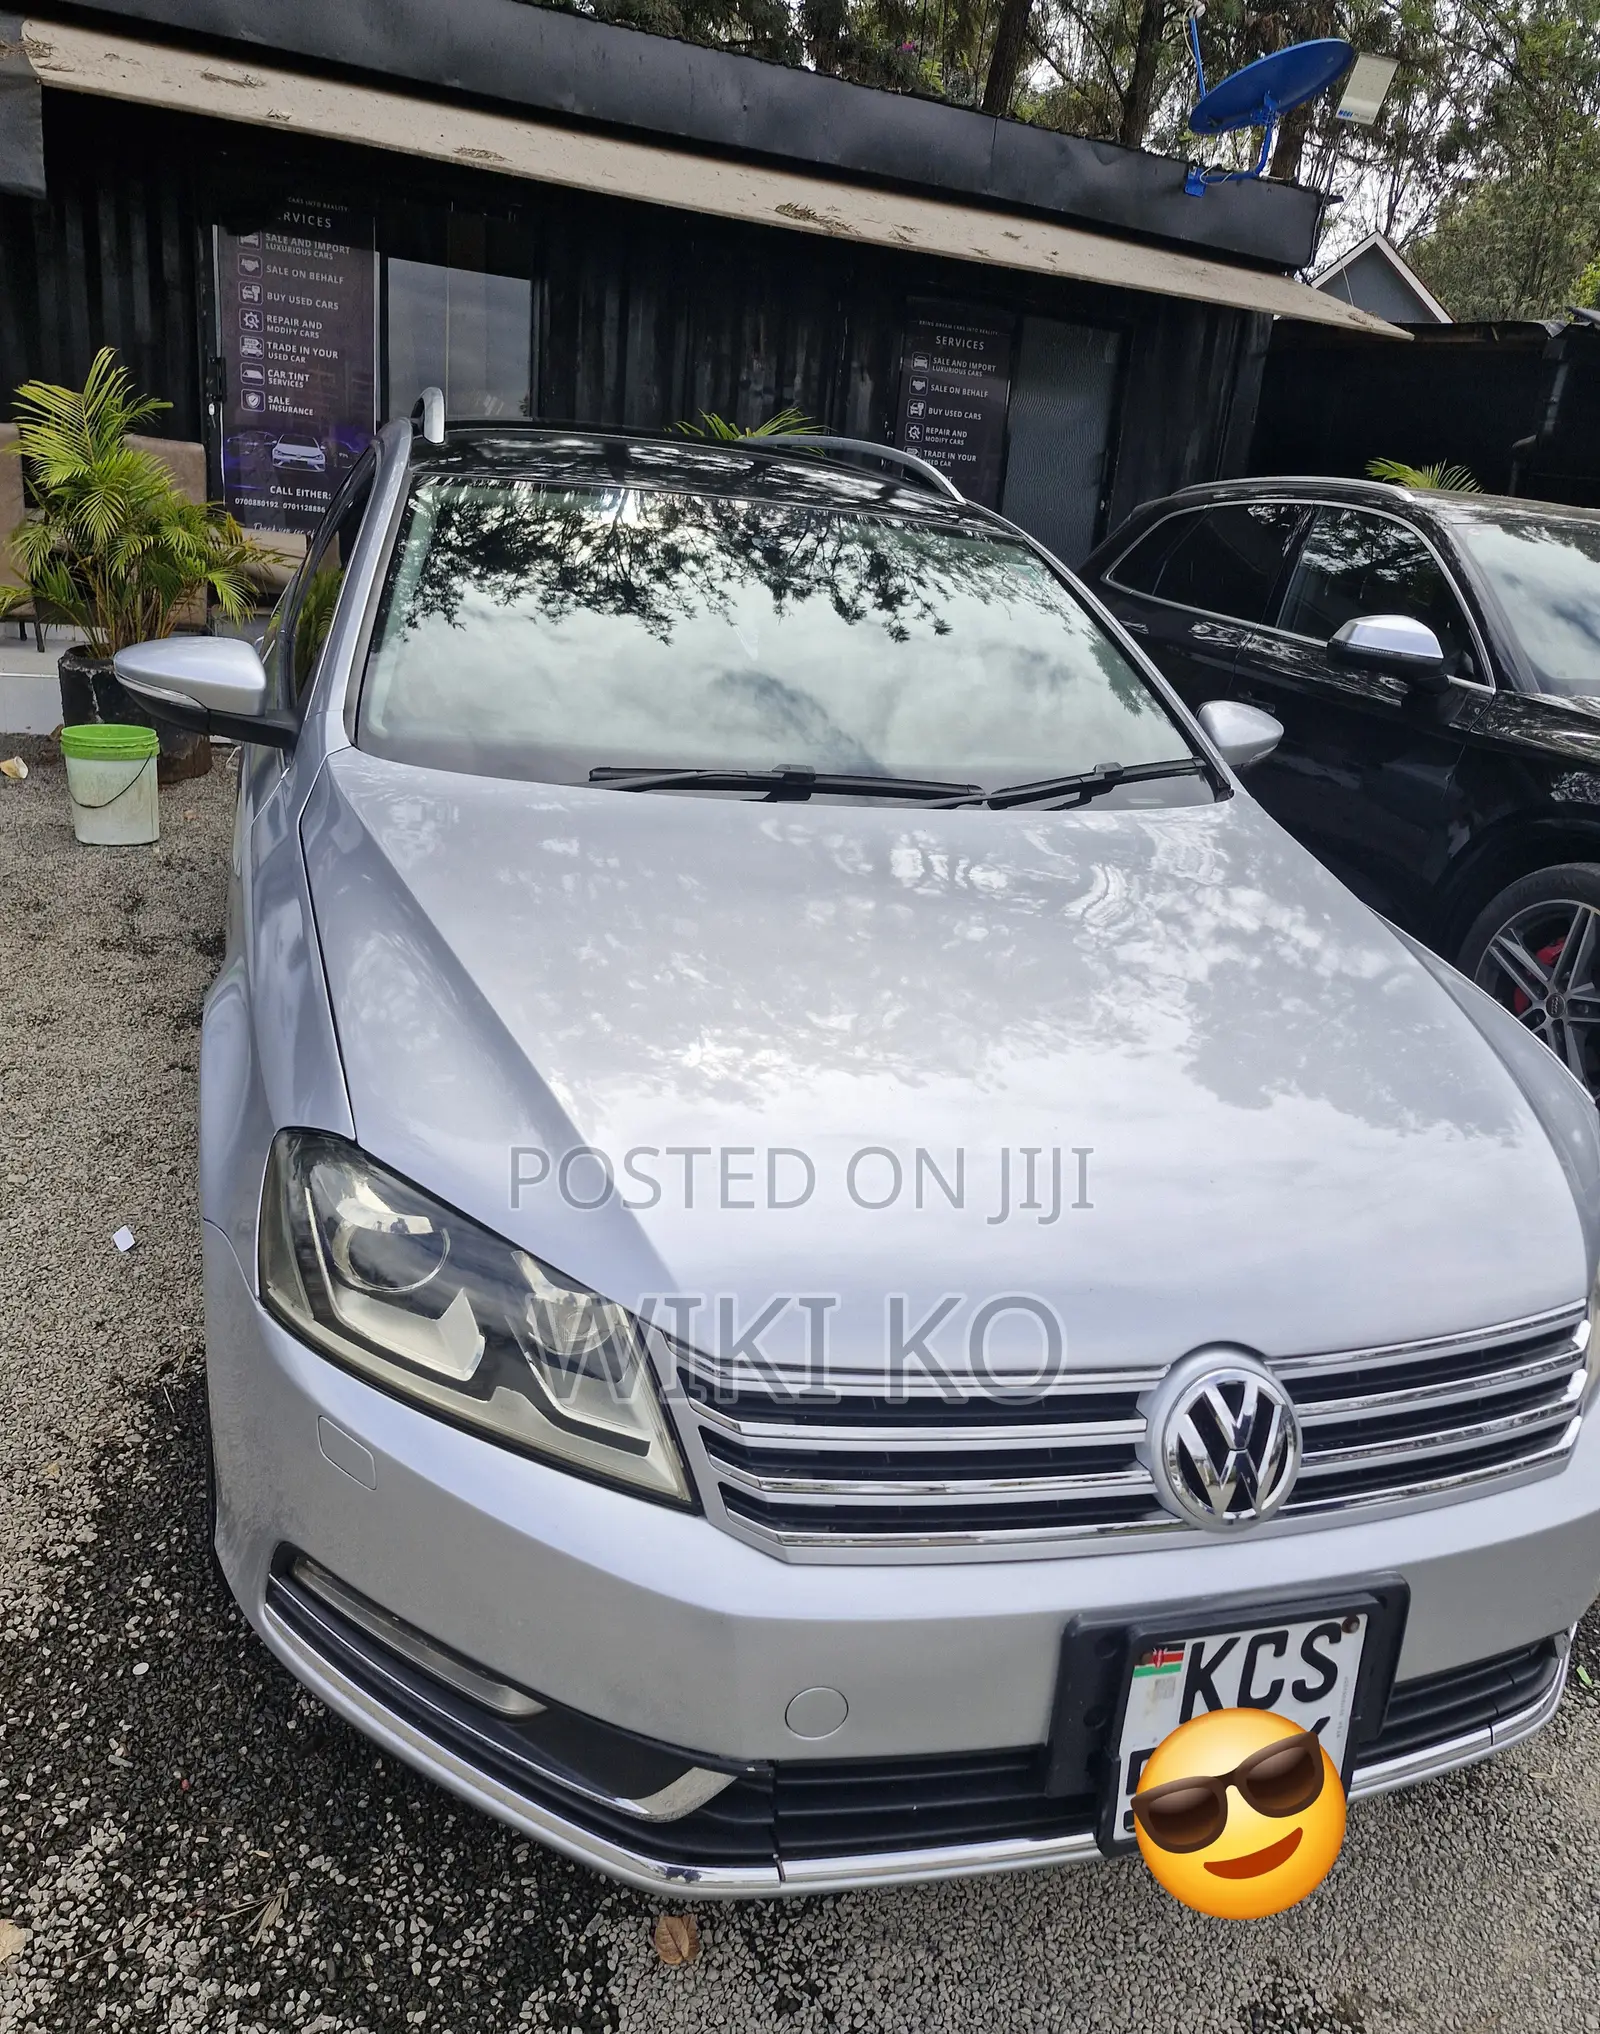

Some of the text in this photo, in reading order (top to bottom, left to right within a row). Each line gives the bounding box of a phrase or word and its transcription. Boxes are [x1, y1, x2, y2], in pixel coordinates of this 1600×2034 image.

[277, 212, 332, 229] RVICES
[265, 233, 351, 255] SALE AND IMPORT
[265, 243, 334, 260] LUXURIOUS CARS
[266, 264, 344, 285] SALE ON BEHALF
[266, 292, 339, 310] BUY USED CARS
[266, 315, 323, 330] REPAIR AND
[266, 325, 320, 339] MODIFY CARS
[935, 335, 985, 351] SERVICES
[266, 342, 339, 359] TRADE IN YOUR
[268, 352, 306, 364] USED CAR
[932, 357, 996, 373] SALE AND IMPORT
[268, 369, 310, 382] CAR TINT
[932, 365, 983, 378] LUXURIOUS CARS
[268, 378, 304, 388] SERVICES
[930, 384, 988, 398] SALE ON BEHALF
[268, 396, 290, 406] SALE
[269, 404, 314, 416] INSURANCE
[928, 407, 982, 420] BUY USED CARS
[926, 426, 968, 438] REPAIR AND
[925, 435, 964, 446] MODIFY CARS
[924, 450, 946, 459] TRADE
[948, 452, 956, 460] IN
[958, 454, 977, 462] YOUR
[940, 459, 952, 468] CAR
[270, 485, 332, 500] CALL EITHER:
[1179, 1621, 1342, 1725] KCS
